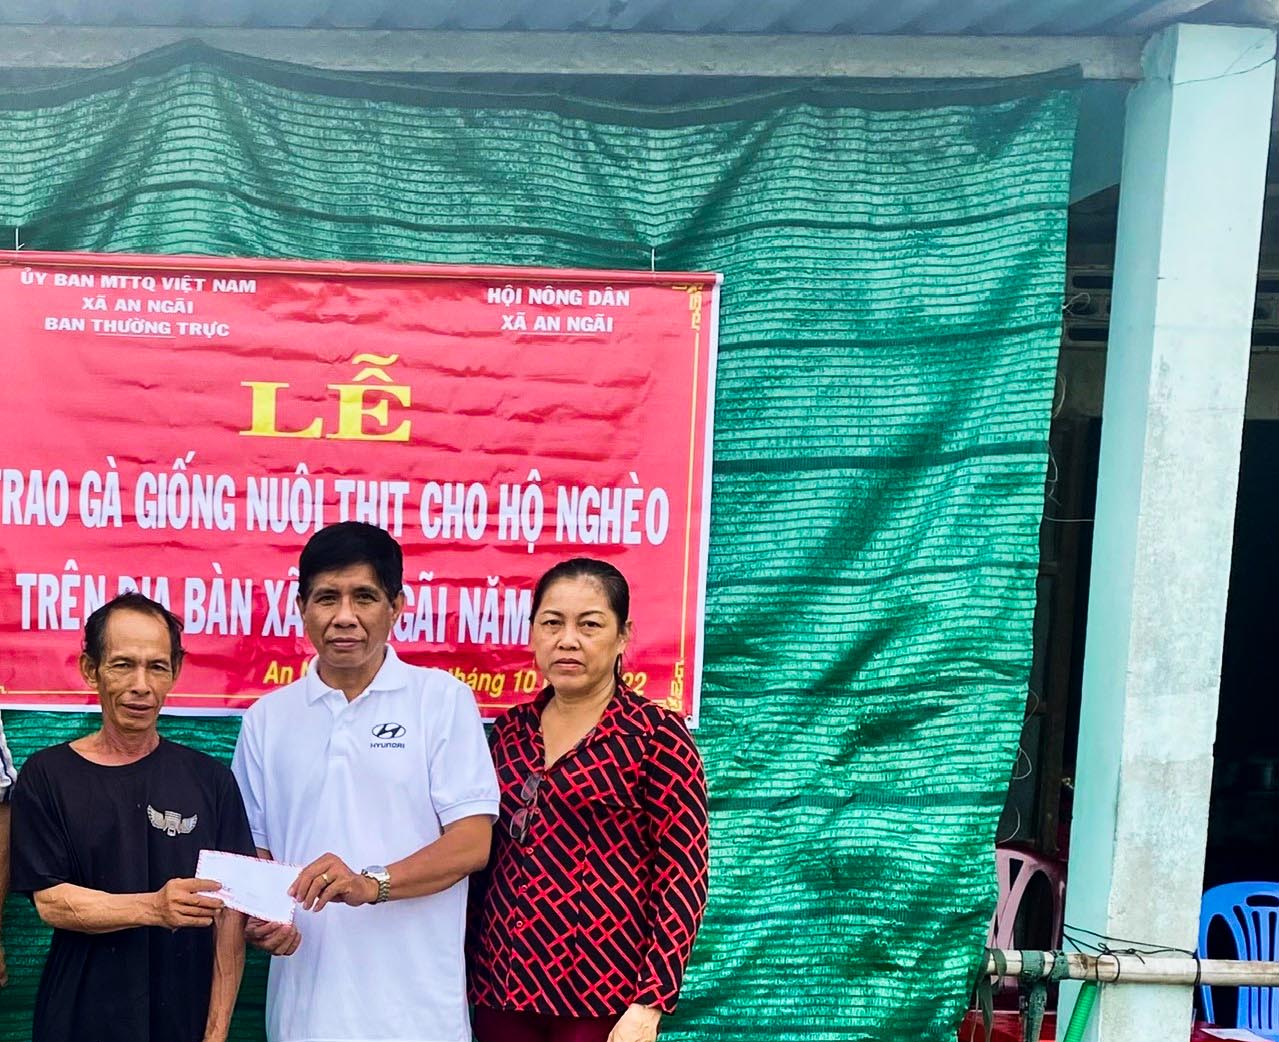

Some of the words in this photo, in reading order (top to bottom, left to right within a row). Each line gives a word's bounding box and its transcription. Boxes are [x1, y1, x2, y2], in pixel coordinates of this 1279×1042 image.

[21, 267, 47, 285] ỦY
[54, 273, 94, 287] BAN
[101, 275, 156, 291] MTTQ
[162, 275, 206, 293] VIỆT
[213, 279, 257, 293] NAM
[82, 294, 107, 311] XÃ
[114, 298, 141, 312] AN
[147, 297, 194, 314] NGÃI
[487, 284, 522, 307] HỘI
[528, 285, 583, 305] NÔNG
[588, 286, 630, 306] DÂN
[45, 317, 85, 331] BAN
[91, 318, 172, 334] THƯỜNG
[176, 321, 230, 338] TRỰC
[501, 311, 527, 330] XÃ
[533, 315, 560, 331] AN
[567, 313, 613, 332] NGÃI
[239, 353, 412, 442] LỄ
[79, 455, 122, 528] GÀ
[135, 450, 236, 531] GIỐNG
[246, 462, 324, 534] NUÔI
[420, 481, 488, 541] CHO
[498, 468, 544, 554] HỘ
[556, 471, 669, 546] NGHÈO
[15, 559, 107, 631] TRÊN
[183, 562, 253, 636] BÀN
[388, 571, 447, 643] GÃI
[458, 576, 533, 645] NĂM
[262, 660, 295, 685] An
[514, 669, 538, 694] 10
